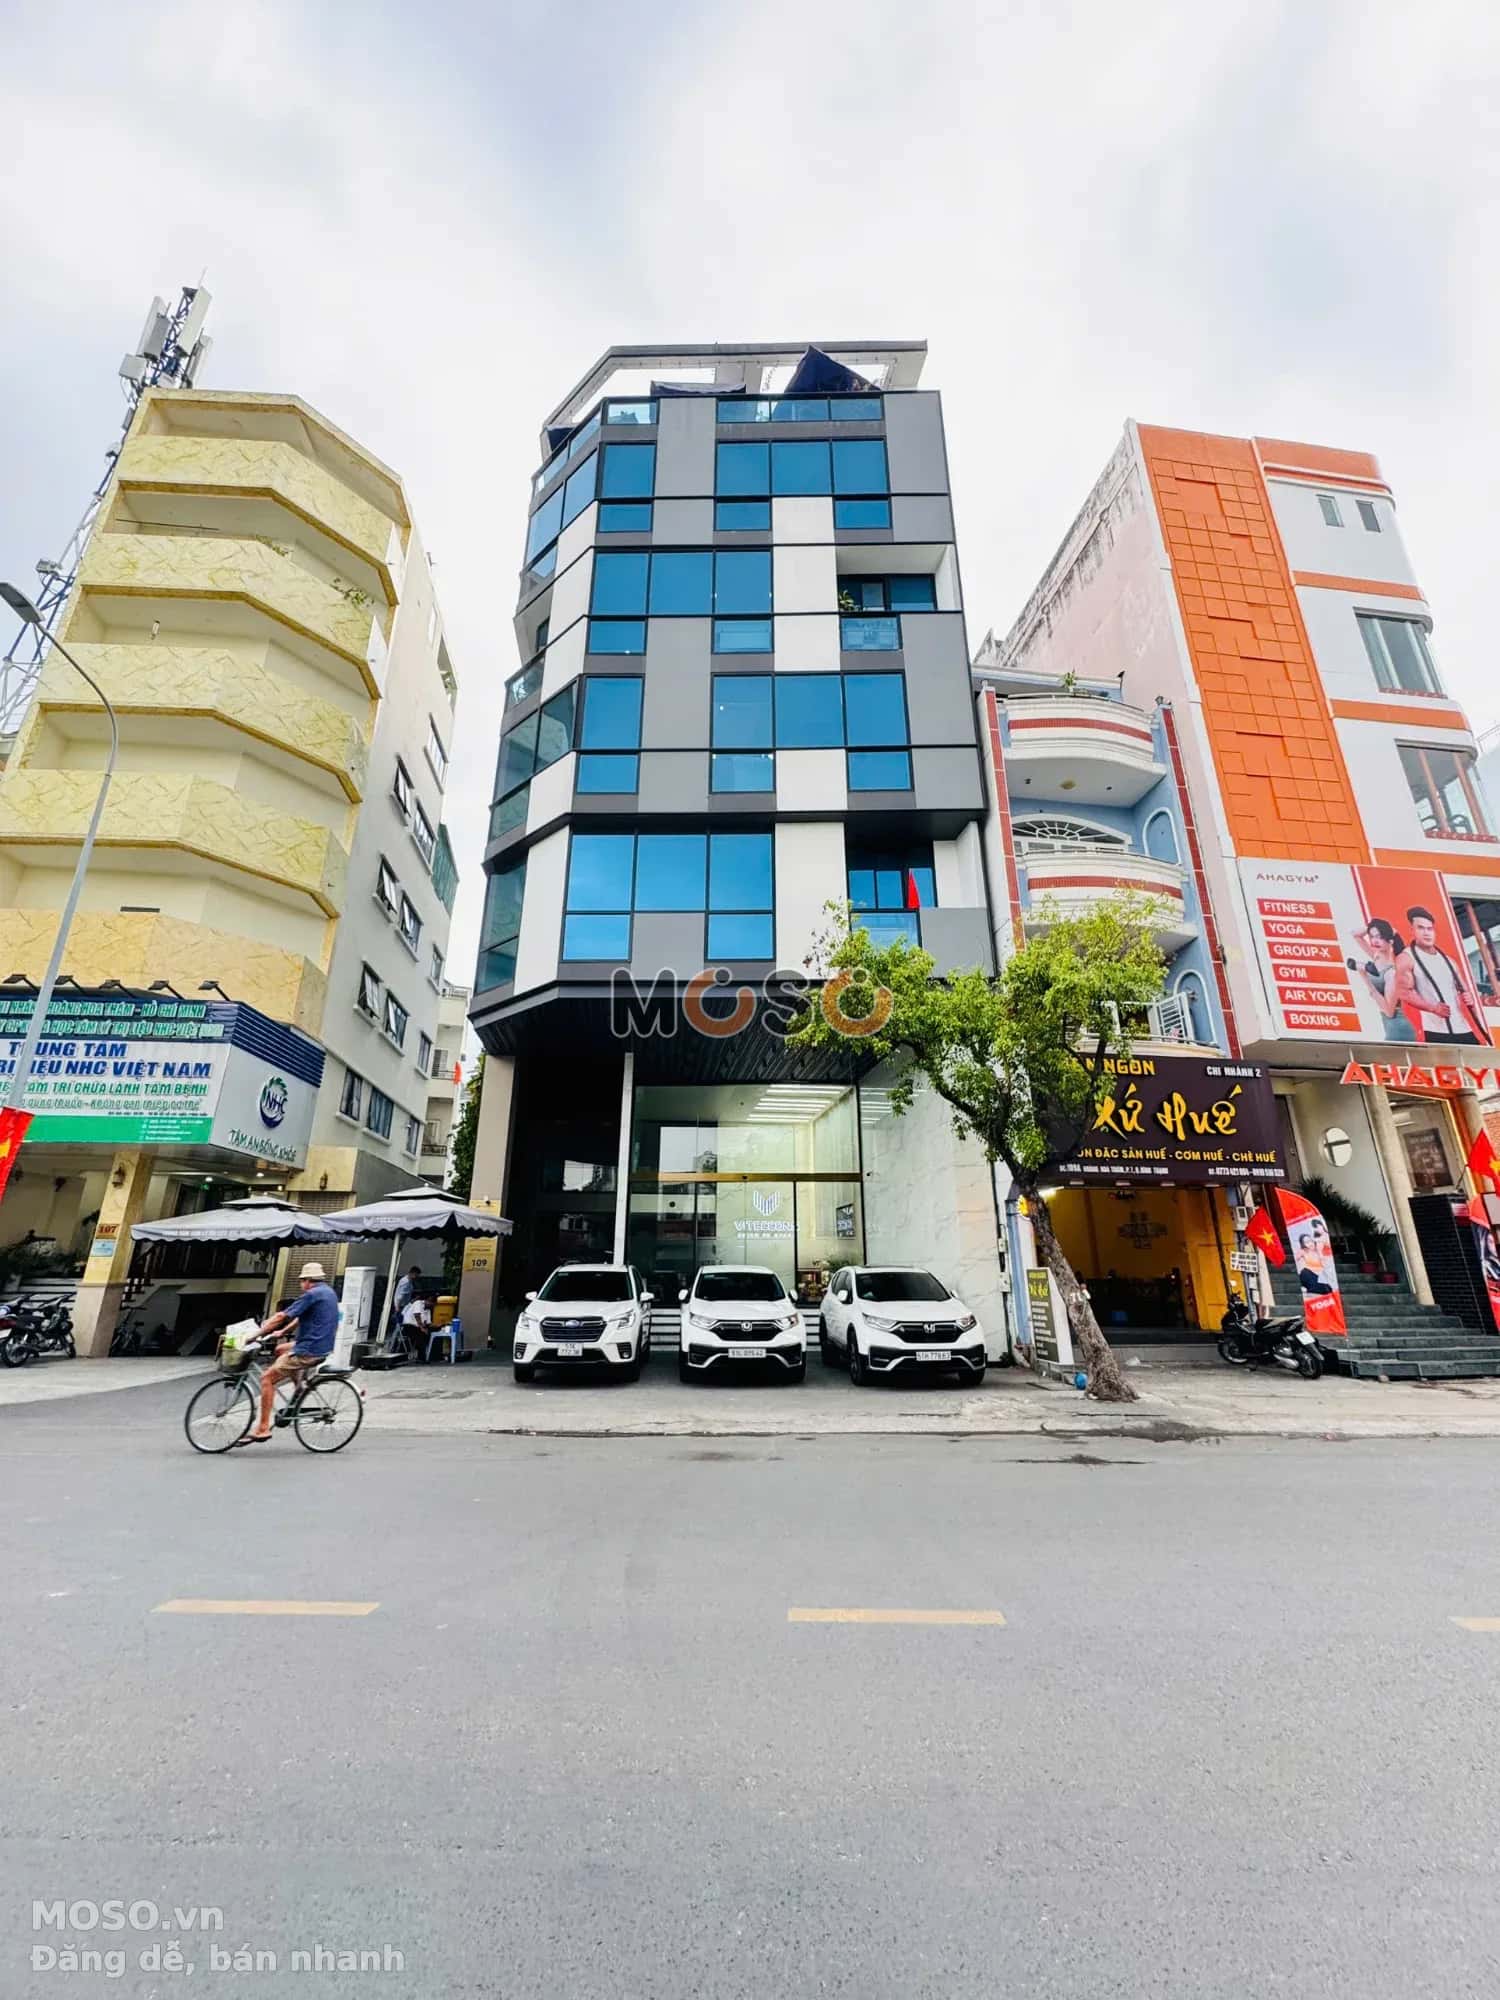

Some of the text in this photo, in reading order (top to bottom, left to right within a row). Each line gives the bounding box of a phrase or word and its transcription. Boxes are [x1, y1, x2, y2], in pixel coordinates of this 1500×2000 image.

[1263, 901, 1316, 915] FITNESS
[1267, 922, 1305, 935] YOGA
[1273, 944, 1331, 958] GROUP-X
[1279, 967, 1308, 979] GYM
[1285, 989, 1347, 1003] AIR YOGA
[1290, 1013, 1340, 1027] BOXING
[9, 1041, 77, 1057] TUNG
[0, 1059, 211, 1081] RỊ IỆU NHC VIỆT NAM
[1206, 1065, 1223, 1077] CHI
[1254, 1067, 1263, 1078] 2
[1156, 1083, 1243, 1142] Huế
[1095, 1147, 1119, 1161] ĐẶC
[1122, 1147, 1144, 1159] SẢN
[1145, 1146, 1167, 1160] HUẾ
[1175, 1150, 1201, 1161] CƠM
[1202, 1148, 1224, 1161] HUẾ
[1255, 1150, 1277, 1163] HUẾ
[98, 1225, 118, 1233] 107
[471, 1258, 488, 1267] 109
[1310, 1297, 1336, 1312] YOGA
